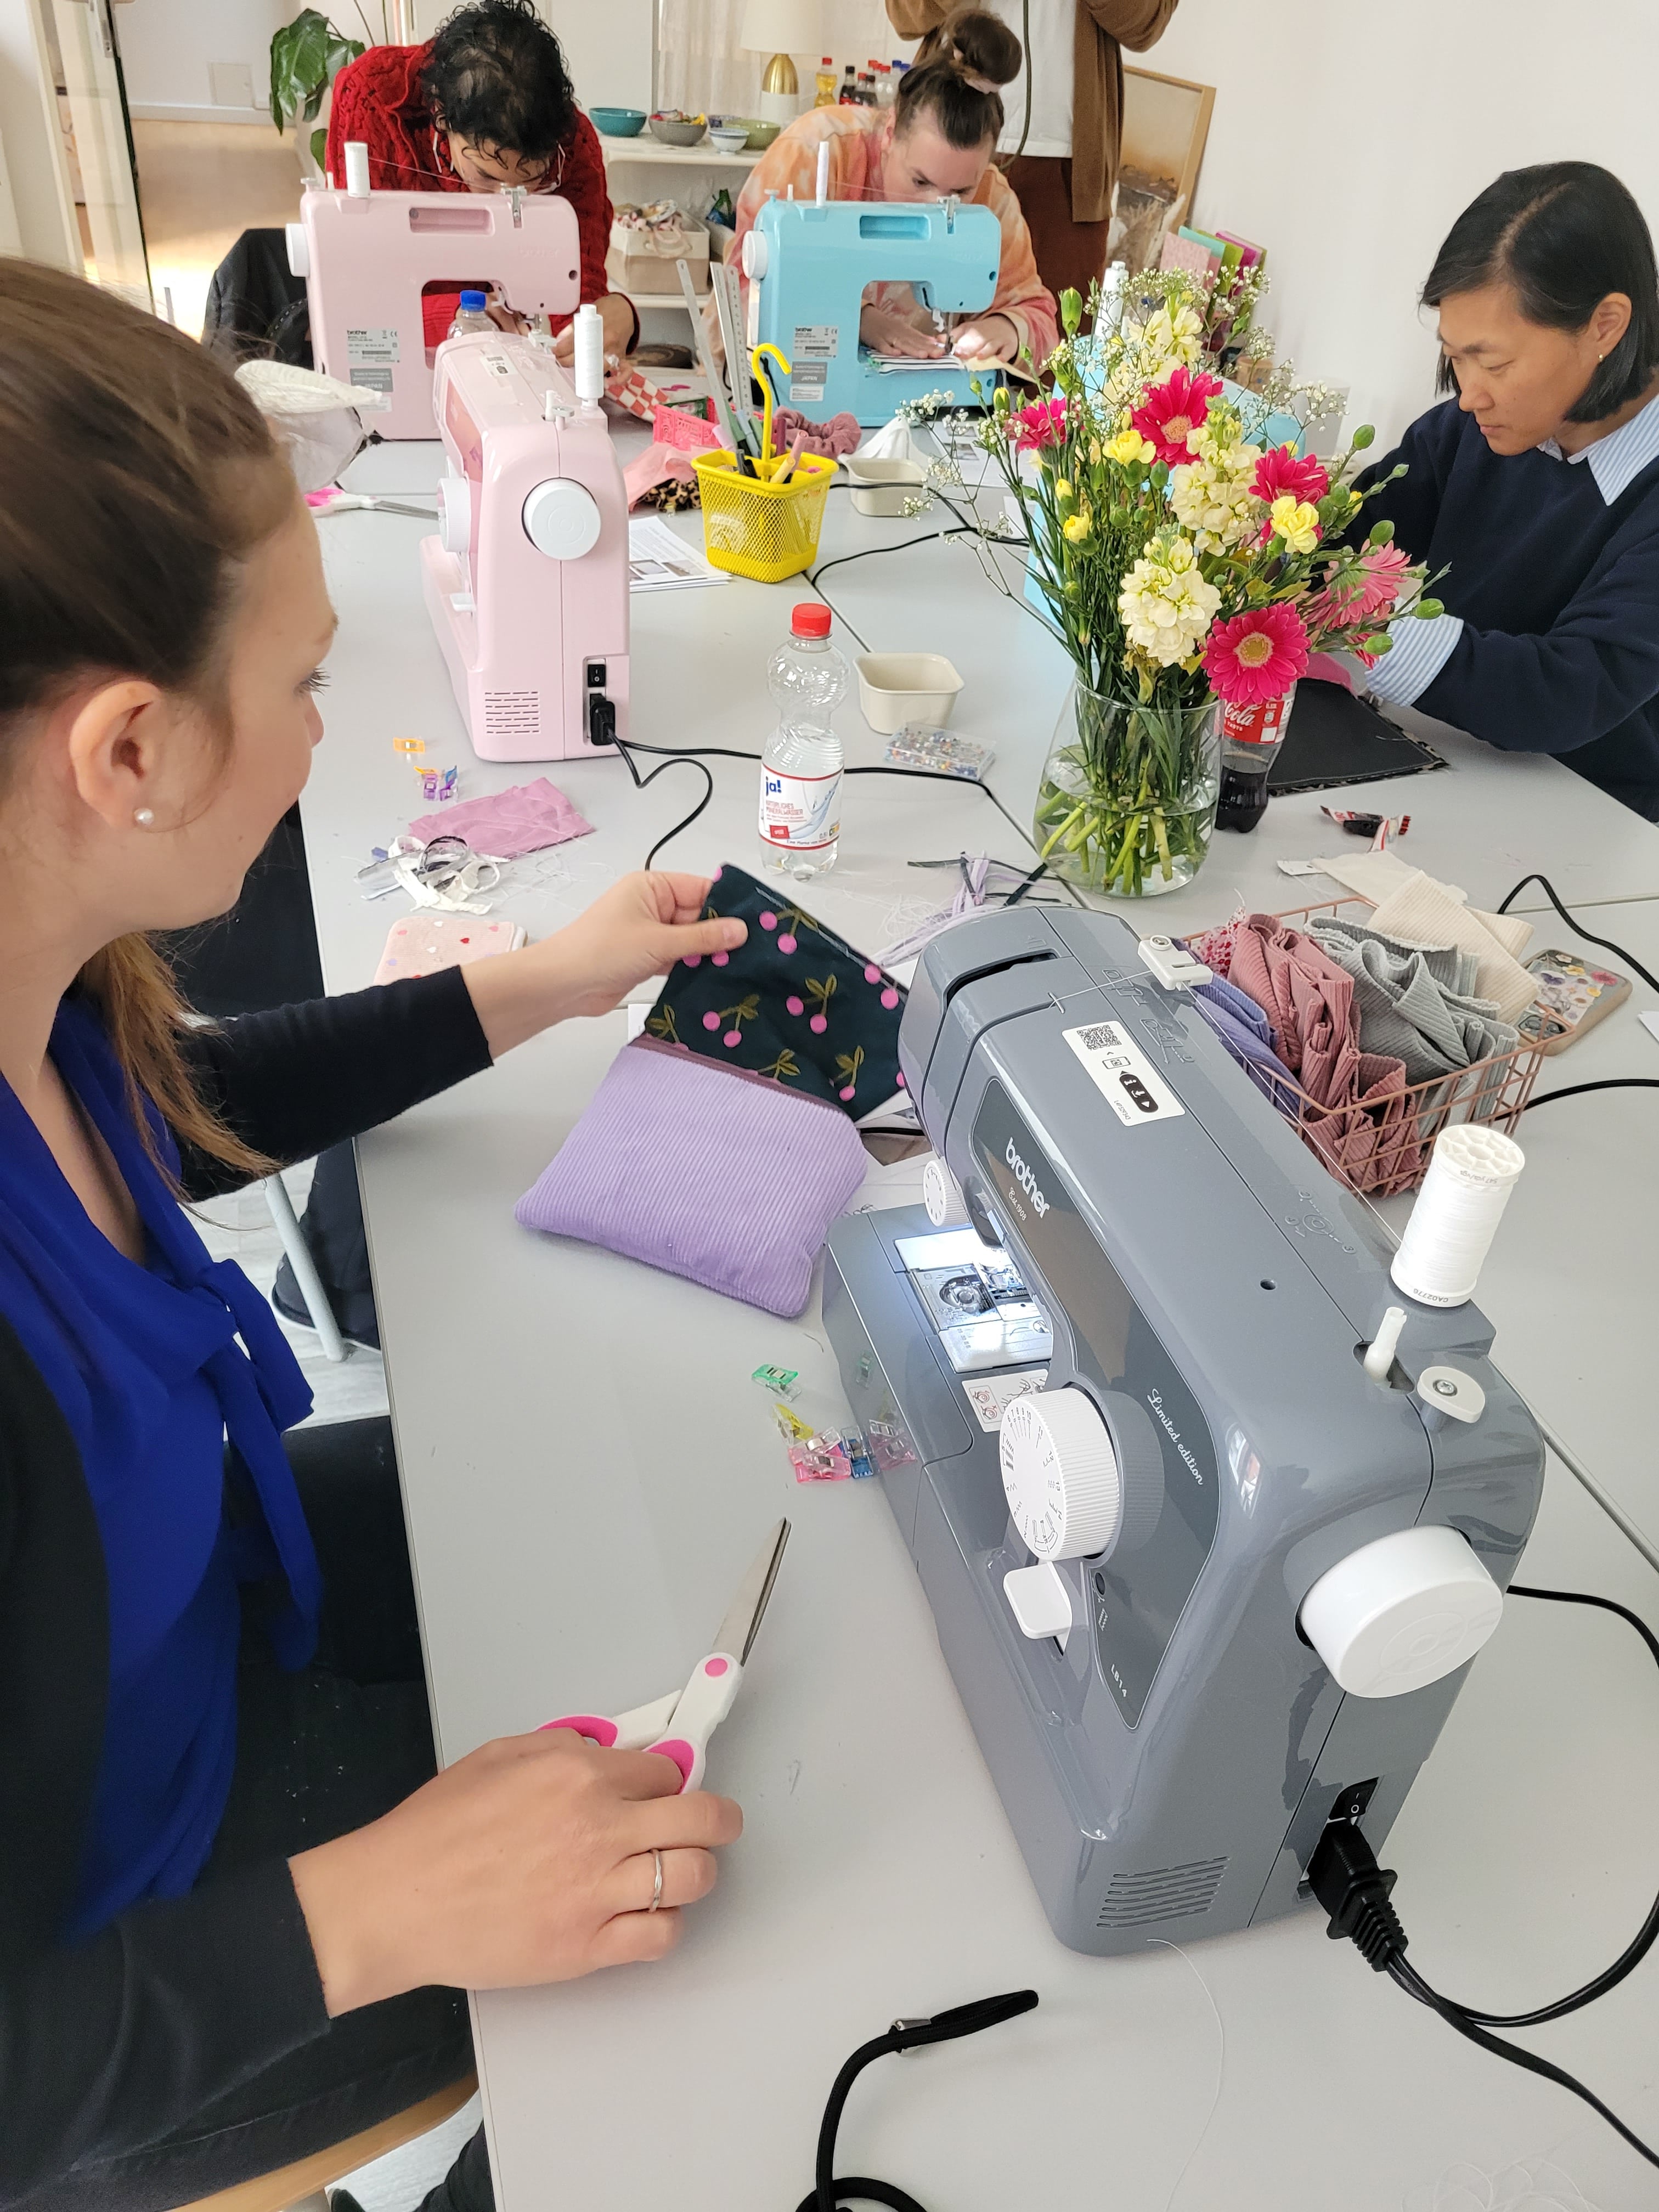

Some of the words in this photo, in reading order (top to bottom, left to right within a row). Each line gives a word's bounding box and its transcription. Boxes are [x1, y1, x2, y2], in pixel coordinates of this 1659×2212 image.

[1224, 702, 1263, 726] Cola
[766, 776, 782, 797] ja!
[1006, 1137, 1050, 1218] brother
[1147, 1388, 1181, 1443] Limited
[1177, 1443, 1203, 1486] edition
[1111, 1663, 1127, 1697] LB14
